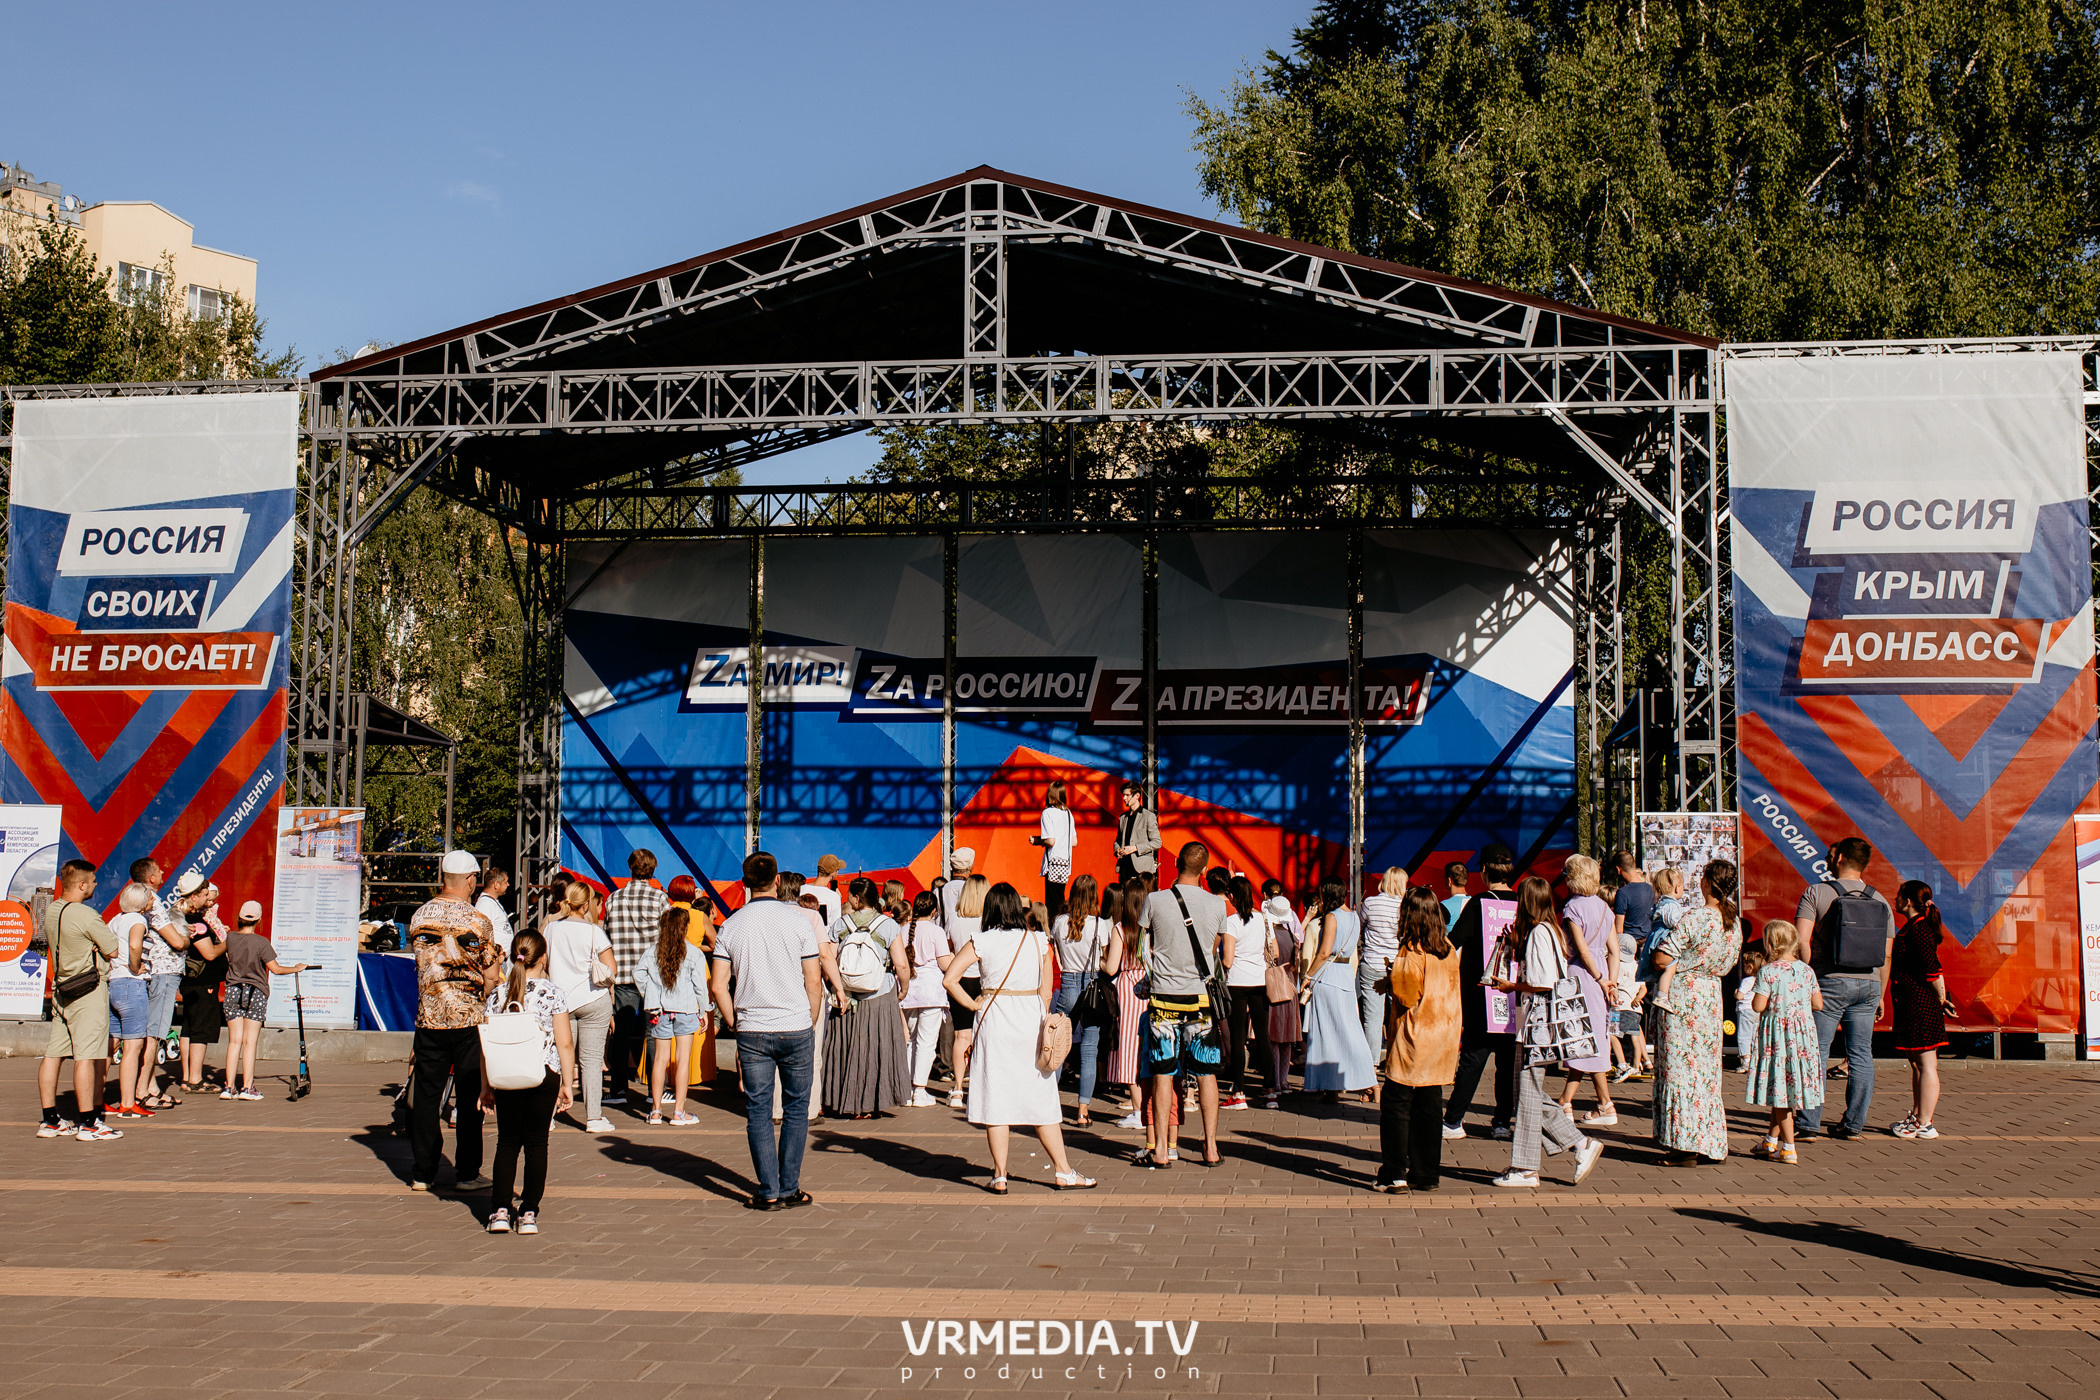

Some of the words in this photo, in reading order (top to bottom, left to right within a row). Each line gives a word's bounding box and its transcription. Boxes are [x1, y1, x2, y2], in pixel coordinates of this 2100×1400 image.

[1832, 498, 2016, 532] РОССИЯ
[80, 524, 226, 556] РОССИЯ
[1854, 570, 1985, 601] КРЫМ
[87, 589, 199, 617] СВОИХ
[50, 645, 92, 672] НЕ
[99, 643, 256, 672] БРОСАЕТ!
[1822, 631, 2020, 668] ДОНБАСС
[764, 661, 846, 687] МИР!
[924, 672, 1087, 700] РОССИЮ!
[1182, 685, 1413, 715] ПРЕЗИДЕНТА!
[211, 769, 275, 850] ПРЕЗИДЕНТА!
[1752, 793, 1819, 861] РОССИЯ
